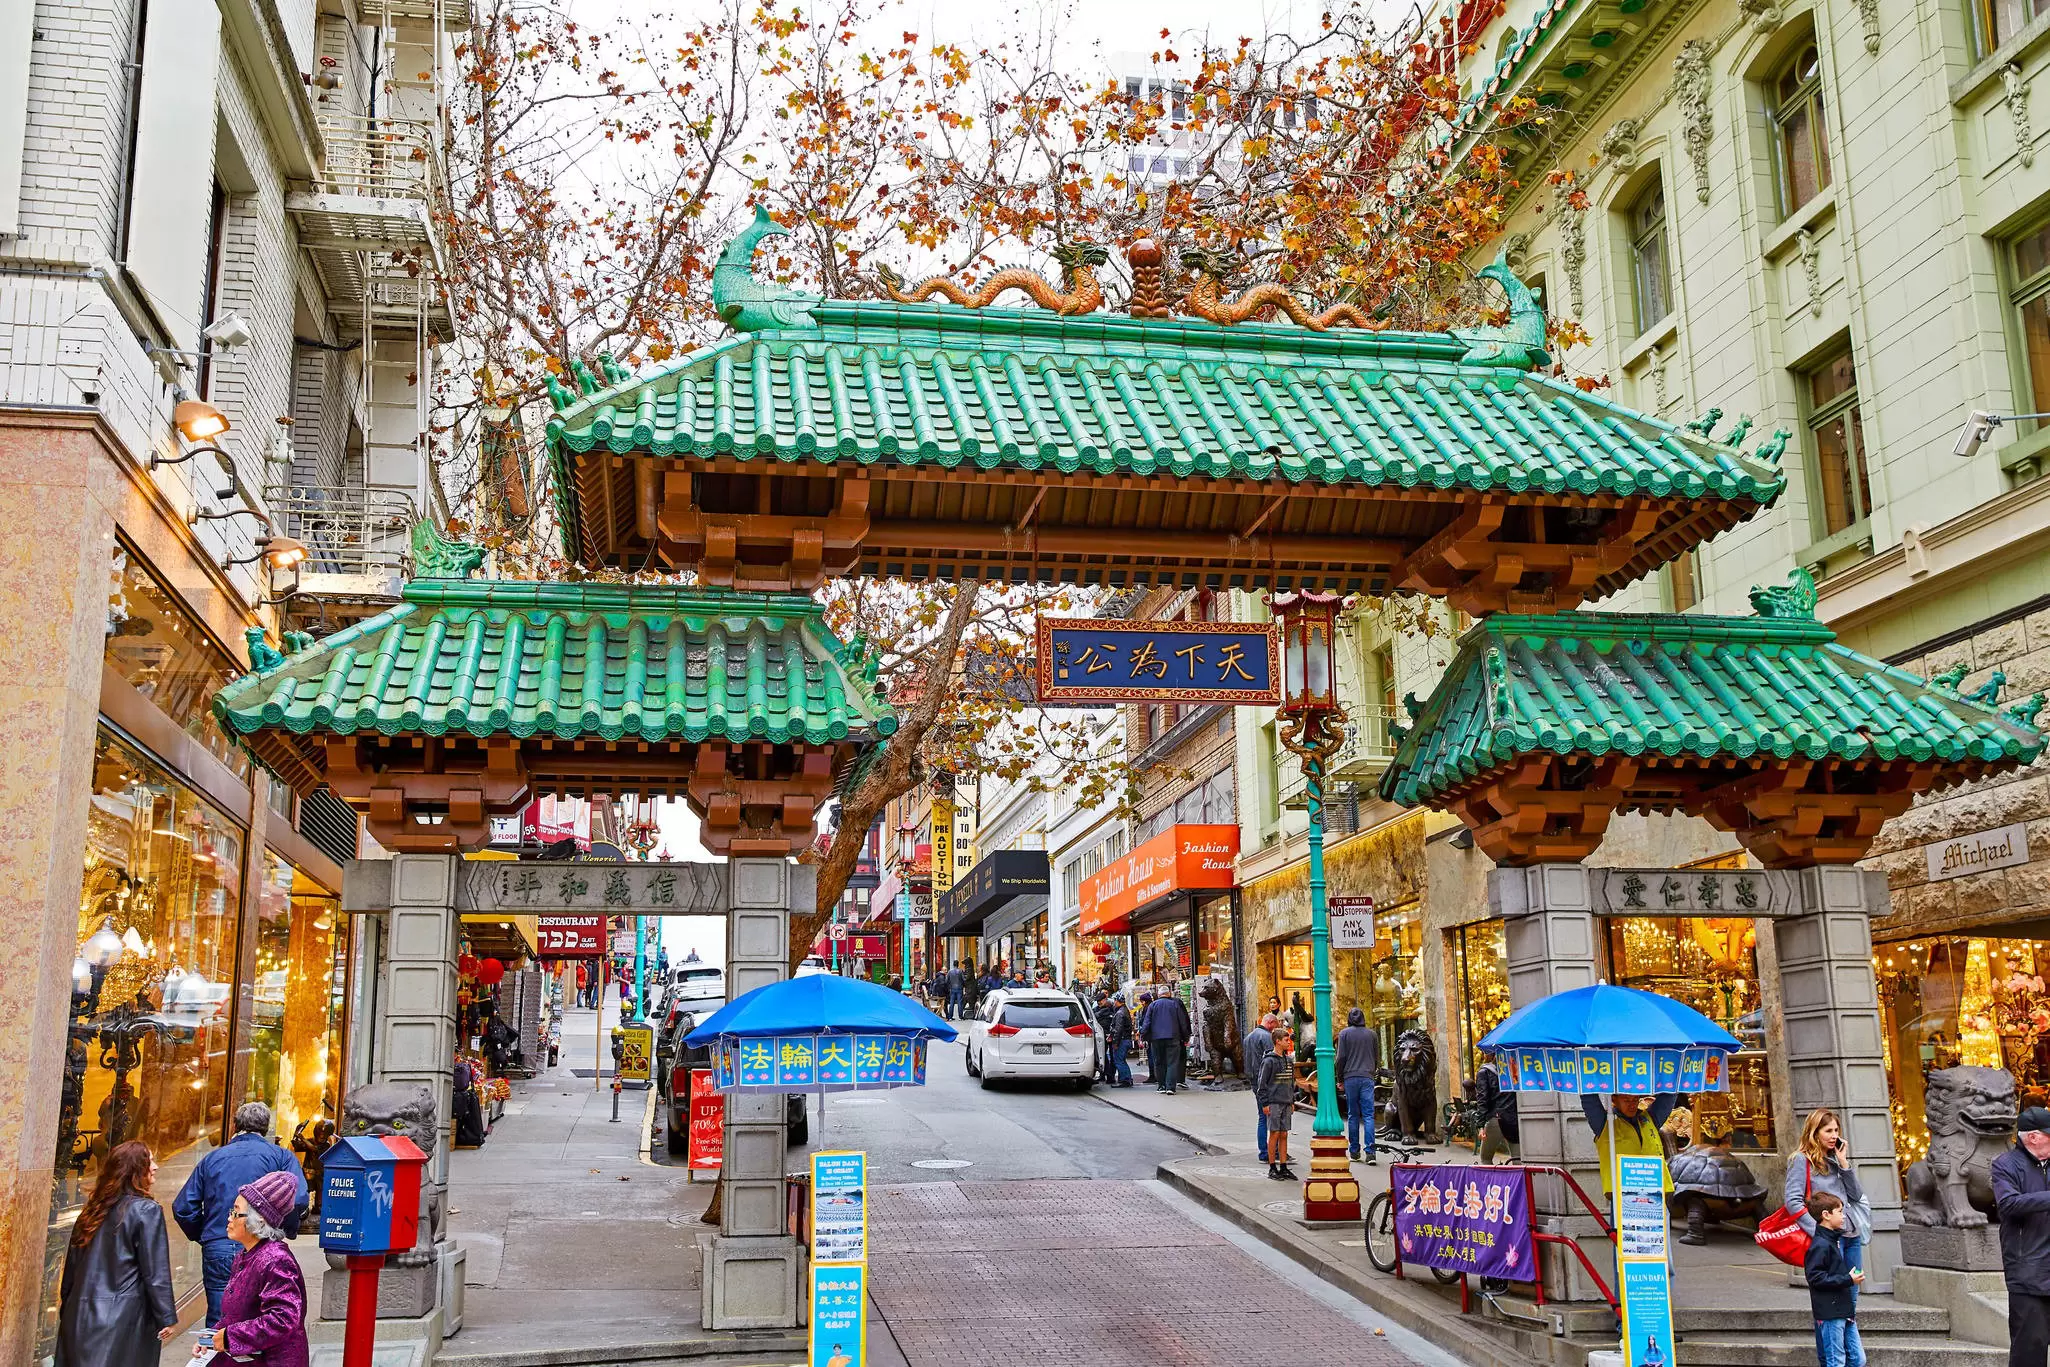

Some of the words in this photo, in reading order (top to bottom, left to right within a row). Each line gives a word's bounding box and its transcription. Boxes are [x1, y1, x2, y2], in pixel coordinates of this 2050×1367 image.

[957, 775, 976, 786] SALE
[934, 825, 949, 834] PRE
[960, 823, 970, 833] TO
[1181, 841, 1229, 855] Fashion
[1941, 832, 2014, 875] Michael
[937, 836, 947, 888] AUCTION
[957, 855, 973, 867] OFF
[1202, 858, 1234, 870] Hous
[1011, 877, 1022, 886] Ship
[1022, 877, 1047, 885] Worldwide
[1093, 867, 1125, 913] Fashion
[1127, 855, 1155, 889] House
[1330, 905, 1344, 916] NO
[1344, 907, 1373, 916] STOPPING
[537, 916, 599, 926] RESTAURANT
[1343, 920, 1362, 929] ANY
[1523, 1055, 1543, 1073] Fa
[1550, 1055, 1576, 1074] Lun
[1582, 1056, 1612, 1075] Da
[1621, 1057, 1648, 1075] Fa
[1658, 1056, 1675, 1074] is
[1682, 1056, 1703, 1074] Great
[700, 1105, 718, 1116] UP
[693, 1119, 716, 1130] 70%
[695, 1137, 710, 1145] Free
[330, 1177, 354, 1188] POLICE
[327, 1189, 357, 1198] TELEPHONE
[326, 1217, 353, 1225] DEPARTMENT
[325, 1231, 353, 1239] ELECTRICITY
[1627, 1273, 1648, 1282] FALUN
[1648, 1273, 1665, 1282] DAFA
